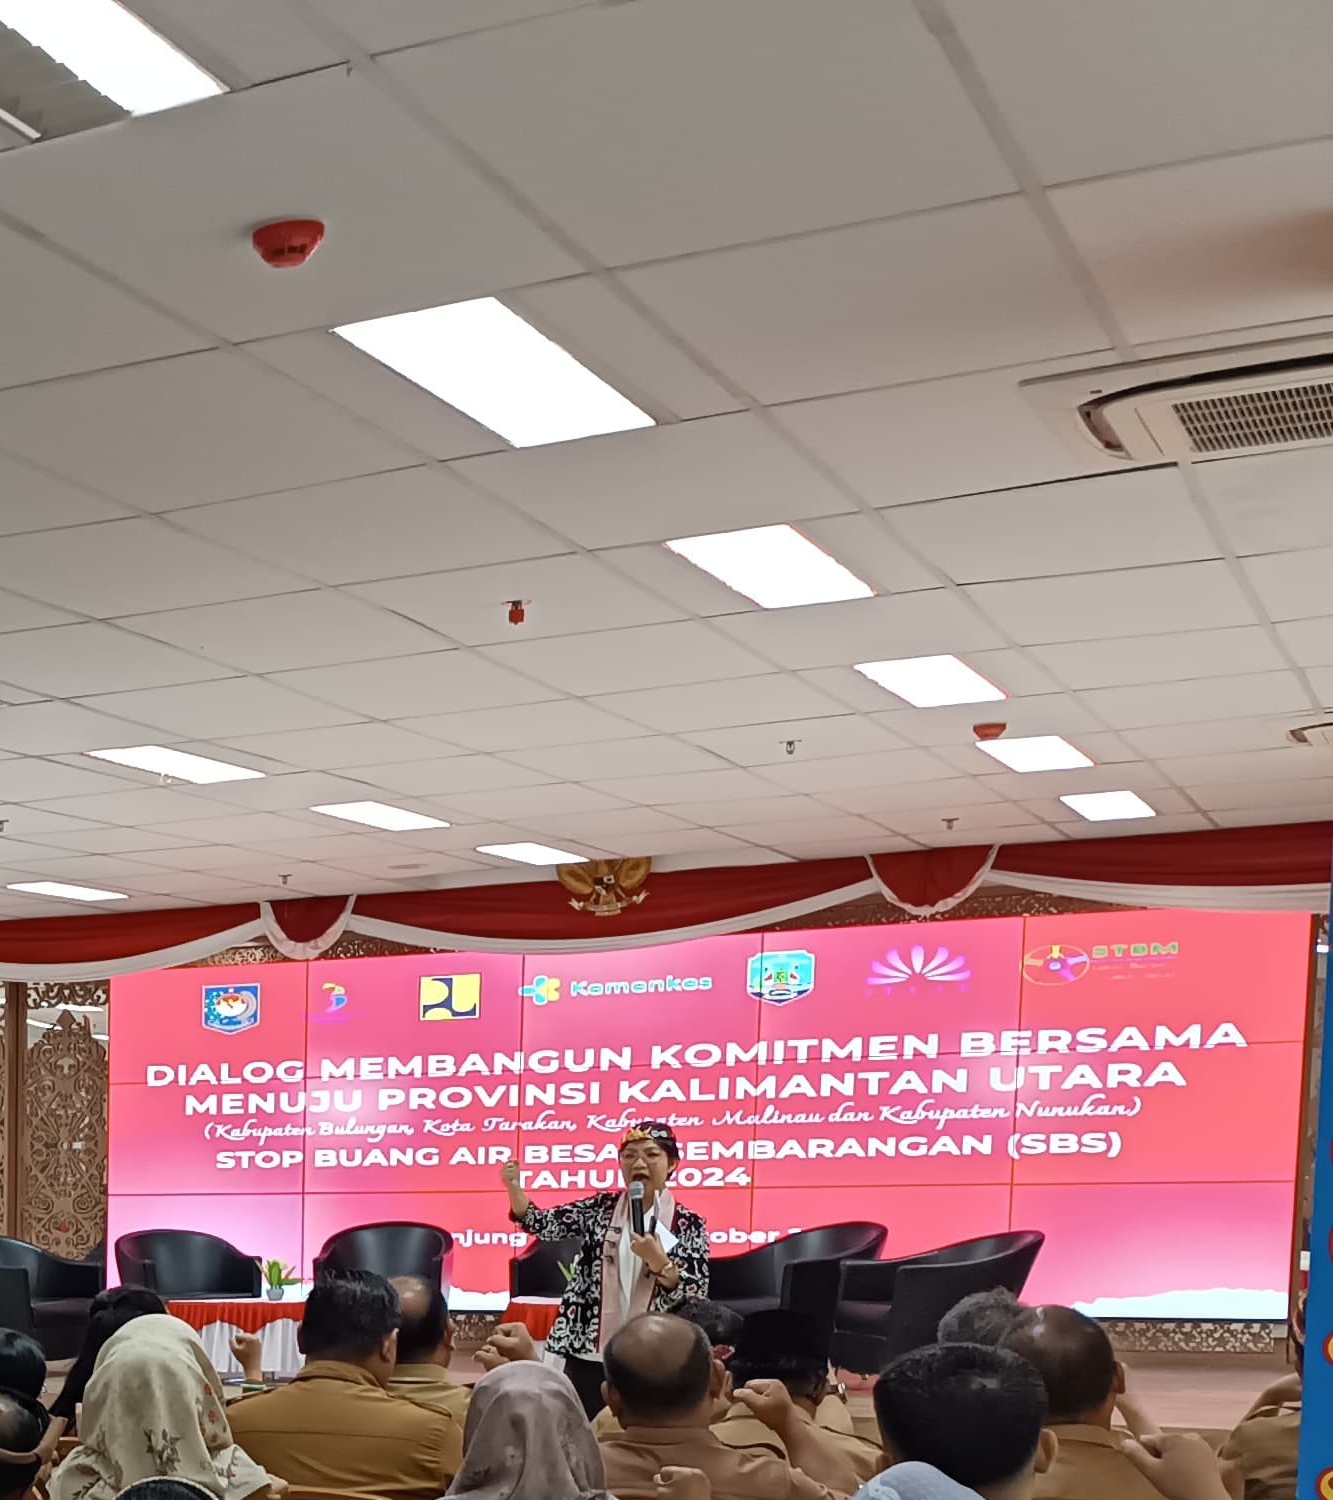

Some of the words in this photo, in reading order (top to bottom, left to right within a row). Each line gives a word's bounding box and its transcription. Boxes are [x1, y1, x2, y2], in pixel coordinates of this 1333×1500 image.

[570, 974, 713, 997] Kemenkes
[146, 1060, 304, 1087] DIALOG
[321, 1047, 632, 1082] MEMBANGUN
[651, 1033, 939, 1069] KOMITMEN
[960, 1022, 1249, 1058] BERSAMA
[185, 1089, 362, 1116] MENUJU
[378, 1081, 600, 1111] PROVINSI
[619, 1068, 968, 1104] KALIMANTAN
[989, 1062, 1187, 1092] UTARA
[423, 1118, 475, 1137] Kota
[712, 1104, 825, 1126] Malinau
[828, 1102, 874, 1123] dan
[879, 1099, 1011, 1130] Kabupaten
[216, 1150, 304, 1169] STOP
[314, 1147, 440, 1168] BUANG
[449, 1146, 512, 1166] AIR
[524, 1143, 620, 1163] BESA
[1007, 1131, 1122, 1160] (SBS)
[450, 1228, 528, 1248] njung
